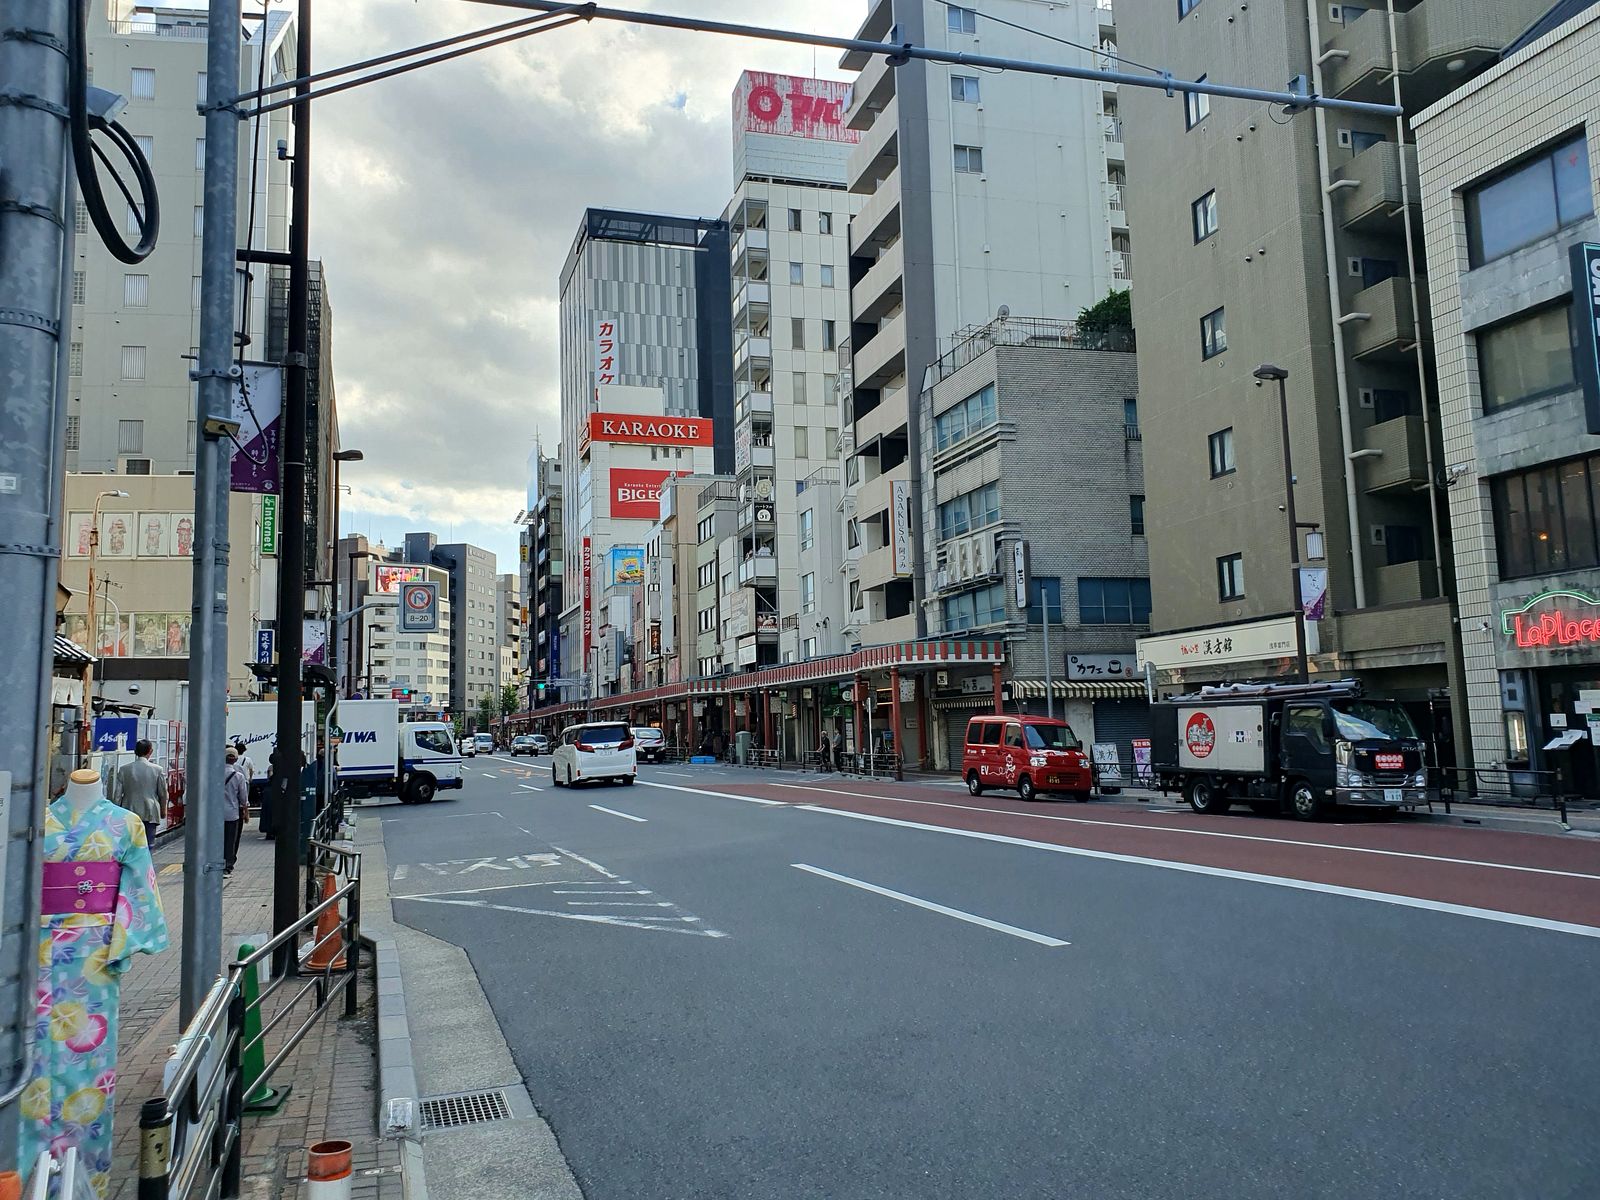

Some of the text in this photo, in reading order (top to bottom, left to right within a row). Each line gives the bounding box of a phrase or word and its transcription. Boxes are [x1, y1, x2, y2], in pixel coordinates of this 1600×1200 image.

[598, 322, 615, 385] カラオケ
[602, 420, 700, 439] KARAOKE
[618, 488, 646, 502] BIG
[897, 486, 905, 544] ASAKUSA
[1077, 663, 1103, 675] カフェ
[980, 765, 989, 776] EV
